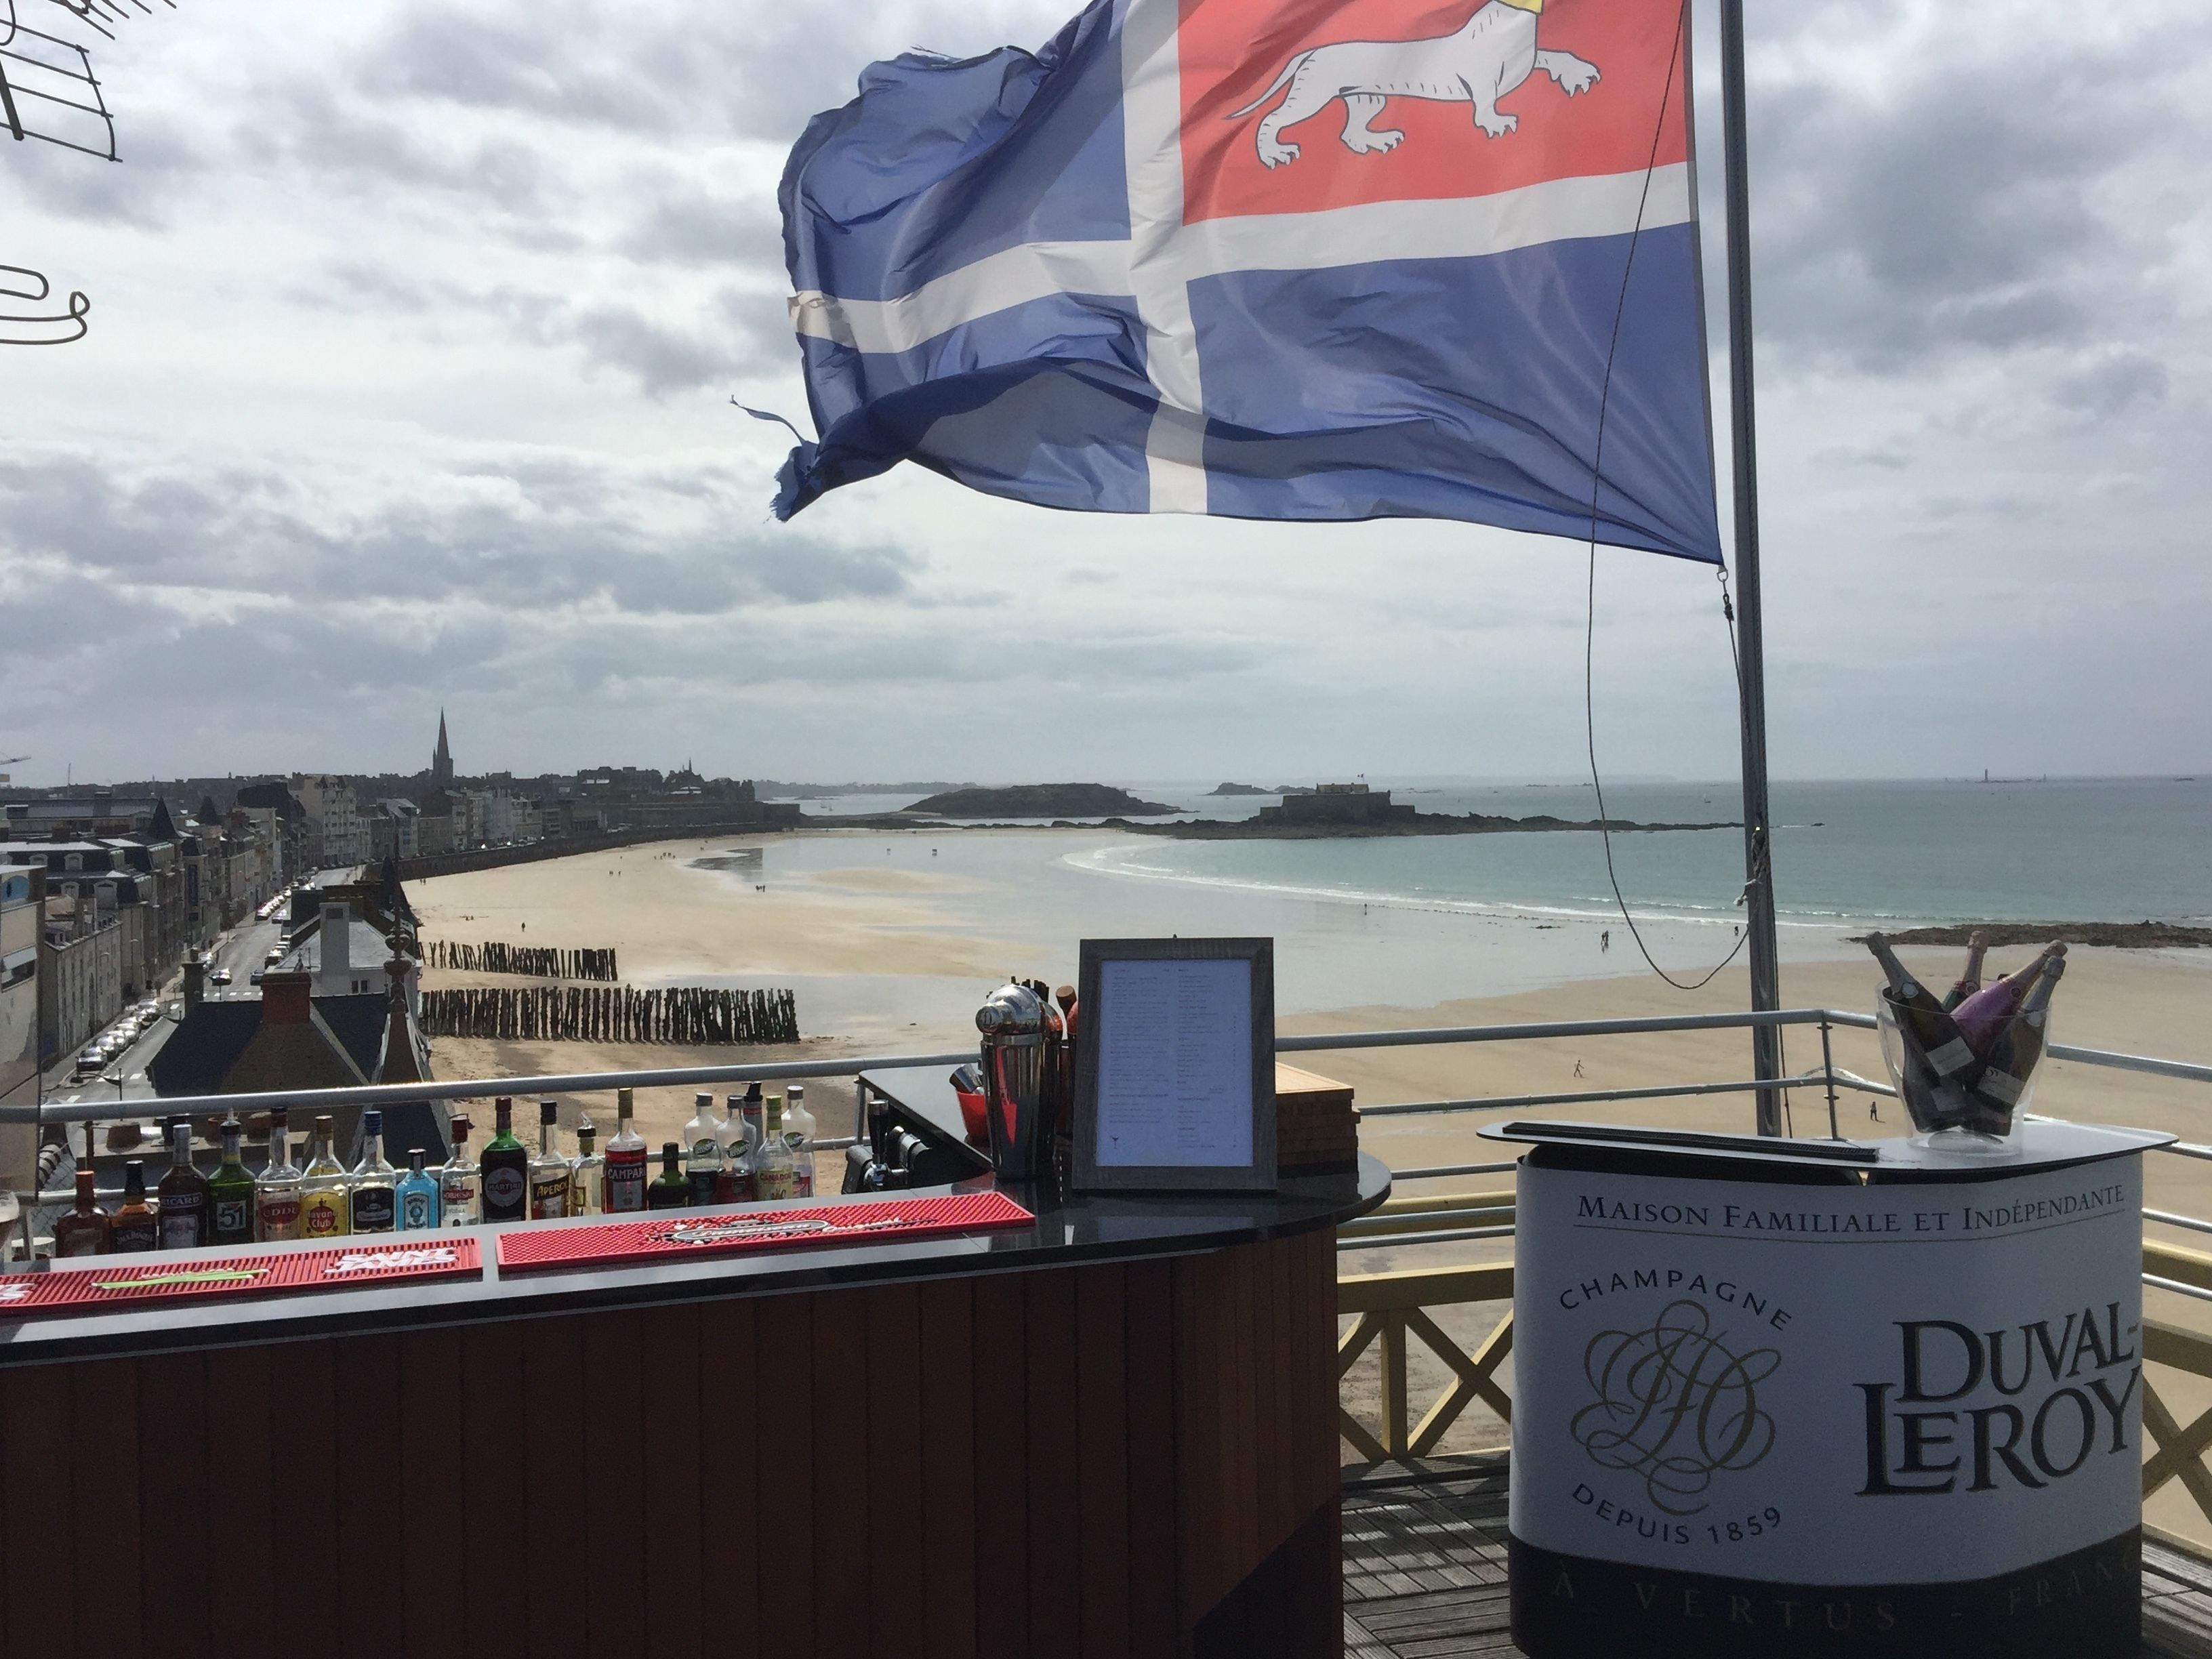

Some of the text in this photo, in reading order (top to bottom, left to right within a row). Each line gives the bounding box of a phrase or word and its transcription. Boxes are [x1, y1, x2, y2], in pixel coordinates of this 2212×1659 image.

[488, 1181, 521, 1189] MARTINI
[1577, 1184, 2125, 1233] MAISON FAMILIALE ET INDÉPENDANTE
[218, 1206, 244, 1229] 51
[311, 1220, 331, 1228] Club
[1559, 1269, 1793, 1332] CHAMPAGNE
[1892, 1301, 2139, 1404] DUVAL-
[1851, 1364, 2142, 1497] LEROY
[1571, 1482, 1782, 1545] DEPUIS 1859
[1633, 1581, 1896, 1630] VERTUS
